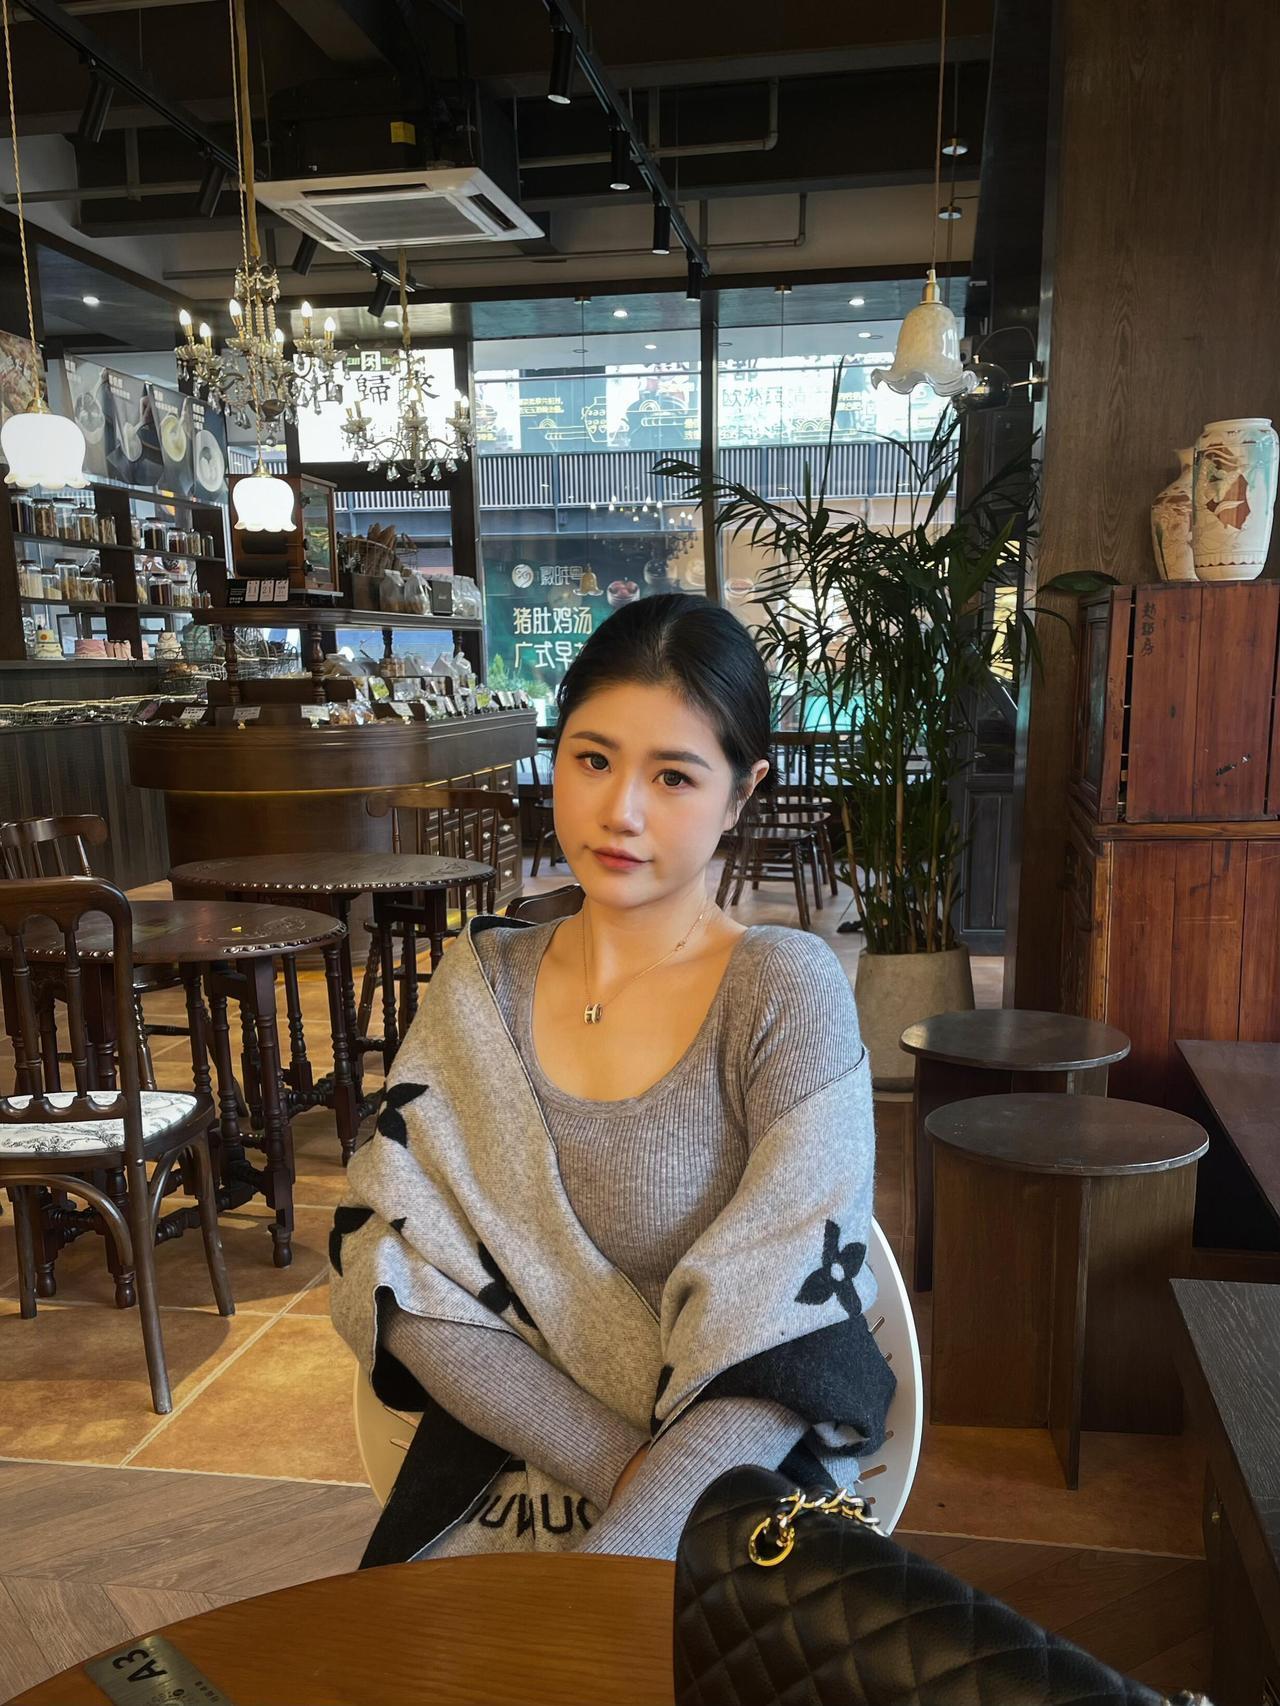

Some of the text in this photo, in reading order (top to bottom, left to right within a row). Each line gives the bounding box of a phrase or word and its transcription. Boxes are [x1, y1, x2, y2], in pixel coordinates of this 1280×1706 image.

[513, 606, 593, 635] 猪肚鸡汤
[514, 640, 586, 671] 广式早
[112, 1648, 168, 1683] A3
